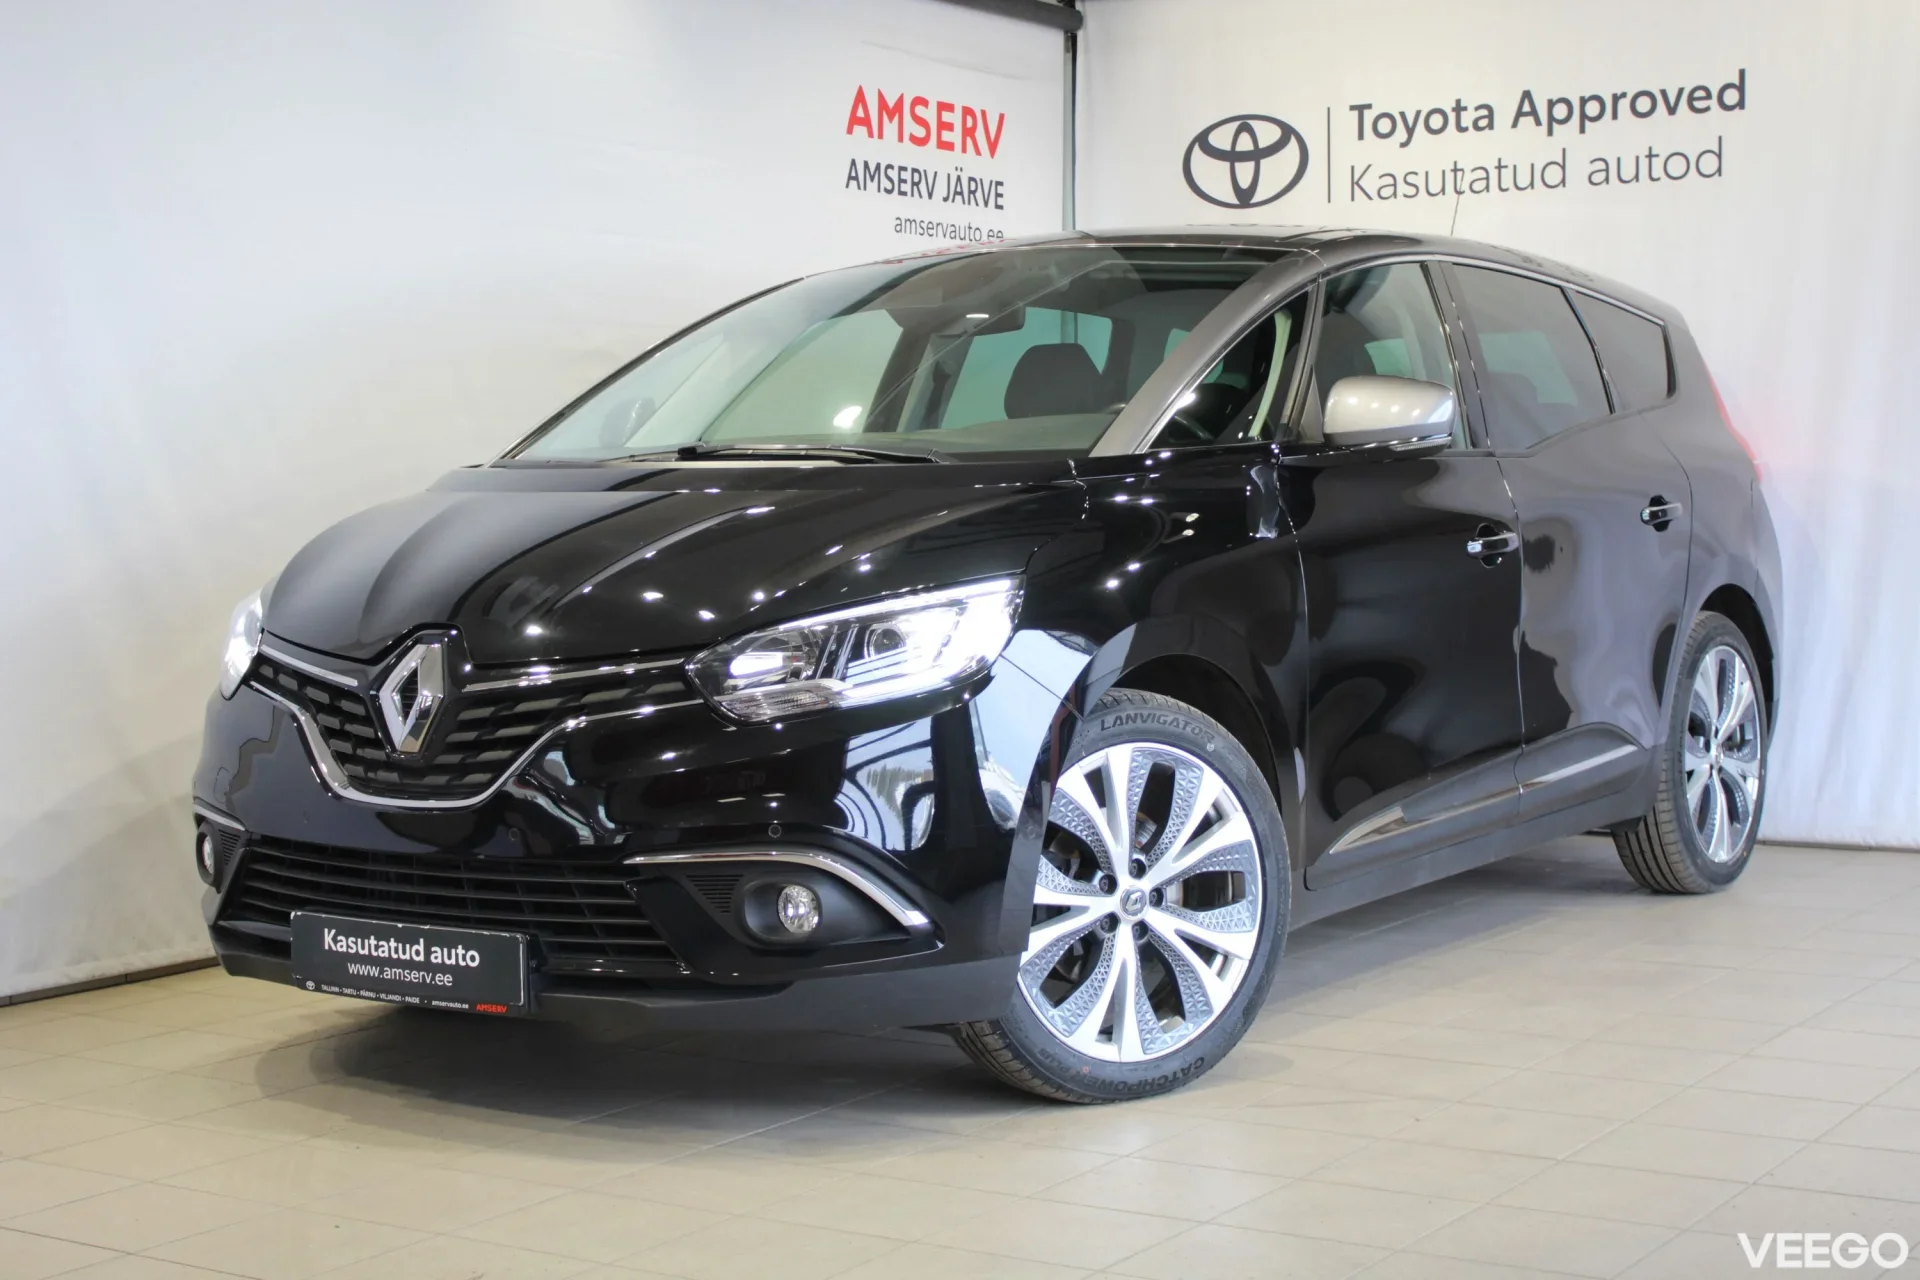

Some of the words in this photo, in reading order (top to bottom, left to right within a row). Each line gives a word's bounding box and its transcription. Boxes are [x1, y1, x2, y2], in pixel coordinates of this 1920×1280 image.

[845, 84, 1005, 160] AMSERV
[1349, 98, 1495, 149] Toyota
[1510, 67, 1746, 137] Approved
[845, 158, 938, 201] AMSERV
[942, 165, 1005, 211] JÄRVE
[1350, 147, 1567, 202] Kasutatud
[1587, 135, 1723, 186] autod
[894, 216, 1004, 243] amservautoee
[1100, 712, 1216, 744] LANVIGATOR
[323, 927, 425, 962] Kasutatud
[430, 944, 481, 968] auto
[321, 984, 340, 993] TALLINN
[342, 987, 357, 995] TARTU
[347, 962, 453, 986] www.amserv.ee
[476, 1003, 508, 1013] AMSERV
